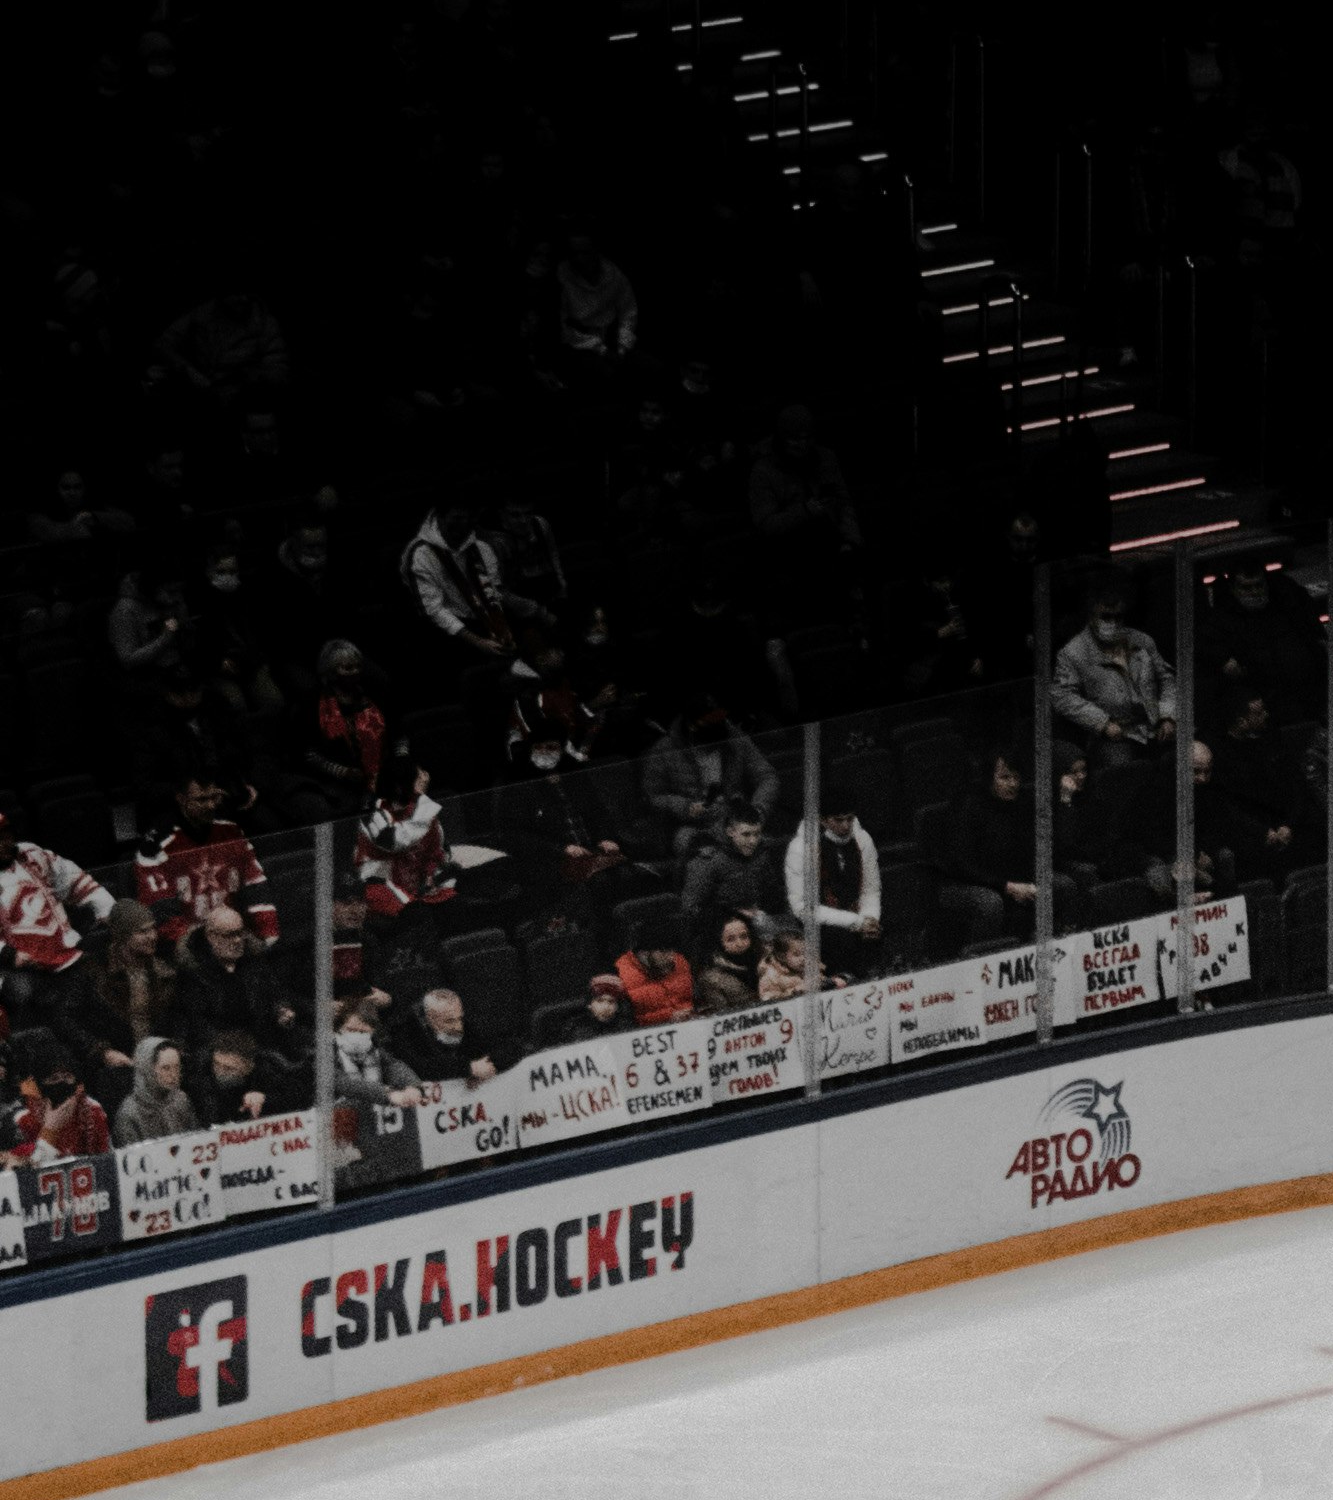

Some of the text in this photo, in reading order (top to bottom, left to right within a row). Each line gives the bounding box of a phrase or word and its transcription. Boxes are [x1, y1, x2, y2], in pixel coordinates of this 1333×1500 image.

[1083, 943, 1141, 973] ВСЕГДА
[1086, 964, 1137, 993] БУДЕТ
[1083, 984, 1146, 1012] ПЕРВЫМ
[631, 1029, 678, 1058] BEST
[779, 1018, 794, 1045] 9
[625, 1051, 700, 1088] 6 & 37
[475, 1114, 510, 1152] GO!
[192, 1142, 219, 1165] 23
[1005, 1127, 1094, 1180] АВТО
[1029, 1151, 1142, 1209] РАДИО
[145, 1209, 172, 1234] 23
[301, 1191, 695, 1359] CSKA.HOCKEY
